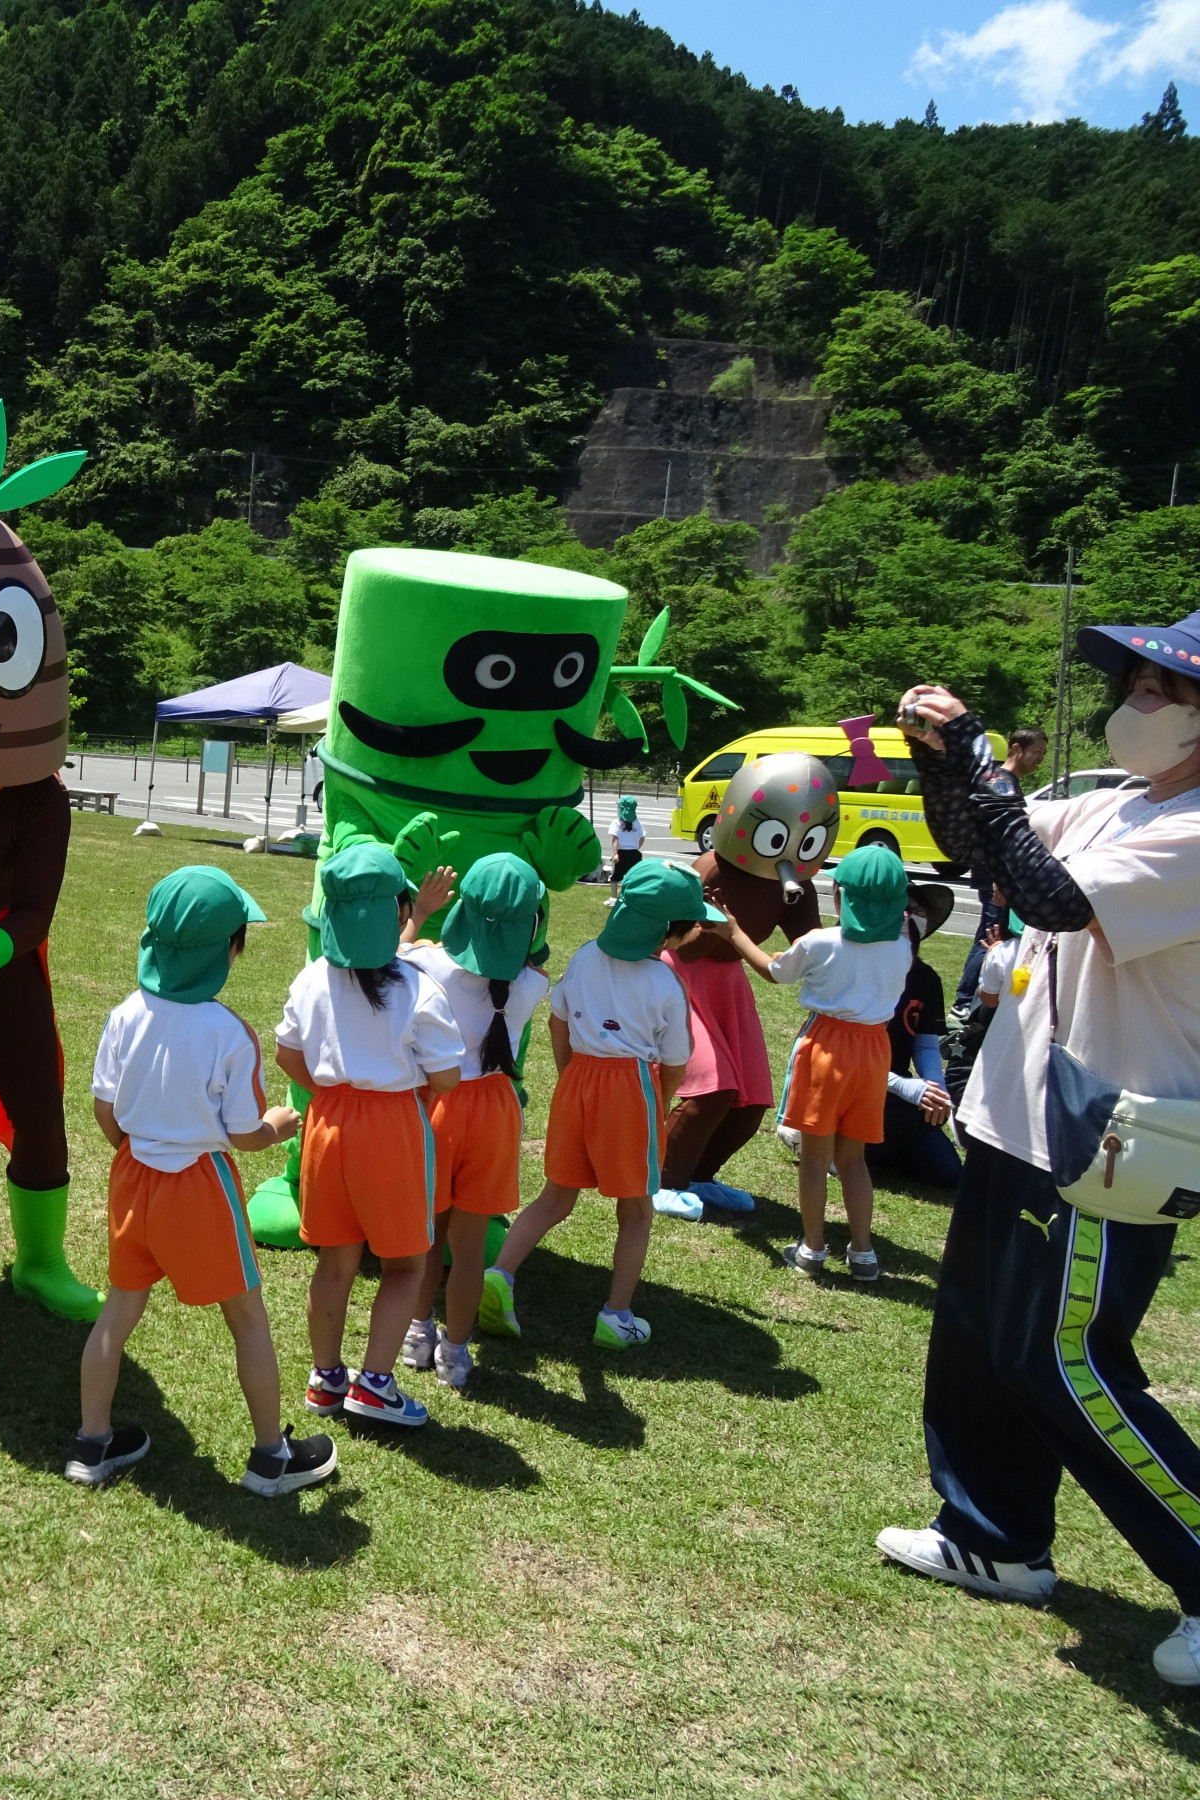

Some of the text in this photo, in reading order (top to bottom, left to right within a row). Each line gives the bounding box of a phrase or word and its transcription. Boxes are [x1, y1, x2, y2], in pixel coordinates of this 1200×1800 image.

[1078, 1212, 1100, 1225] PUMA
[1073, 1252, 1098, 1264] PUMA
[1068, 1292, 1092, 1304] PUMA
[1064, 1358, 1086, 1368] PUMA
[1080, 1389, 1104, 1403] PUMA
[1104, 1421, 1126, 1437] PUMA
